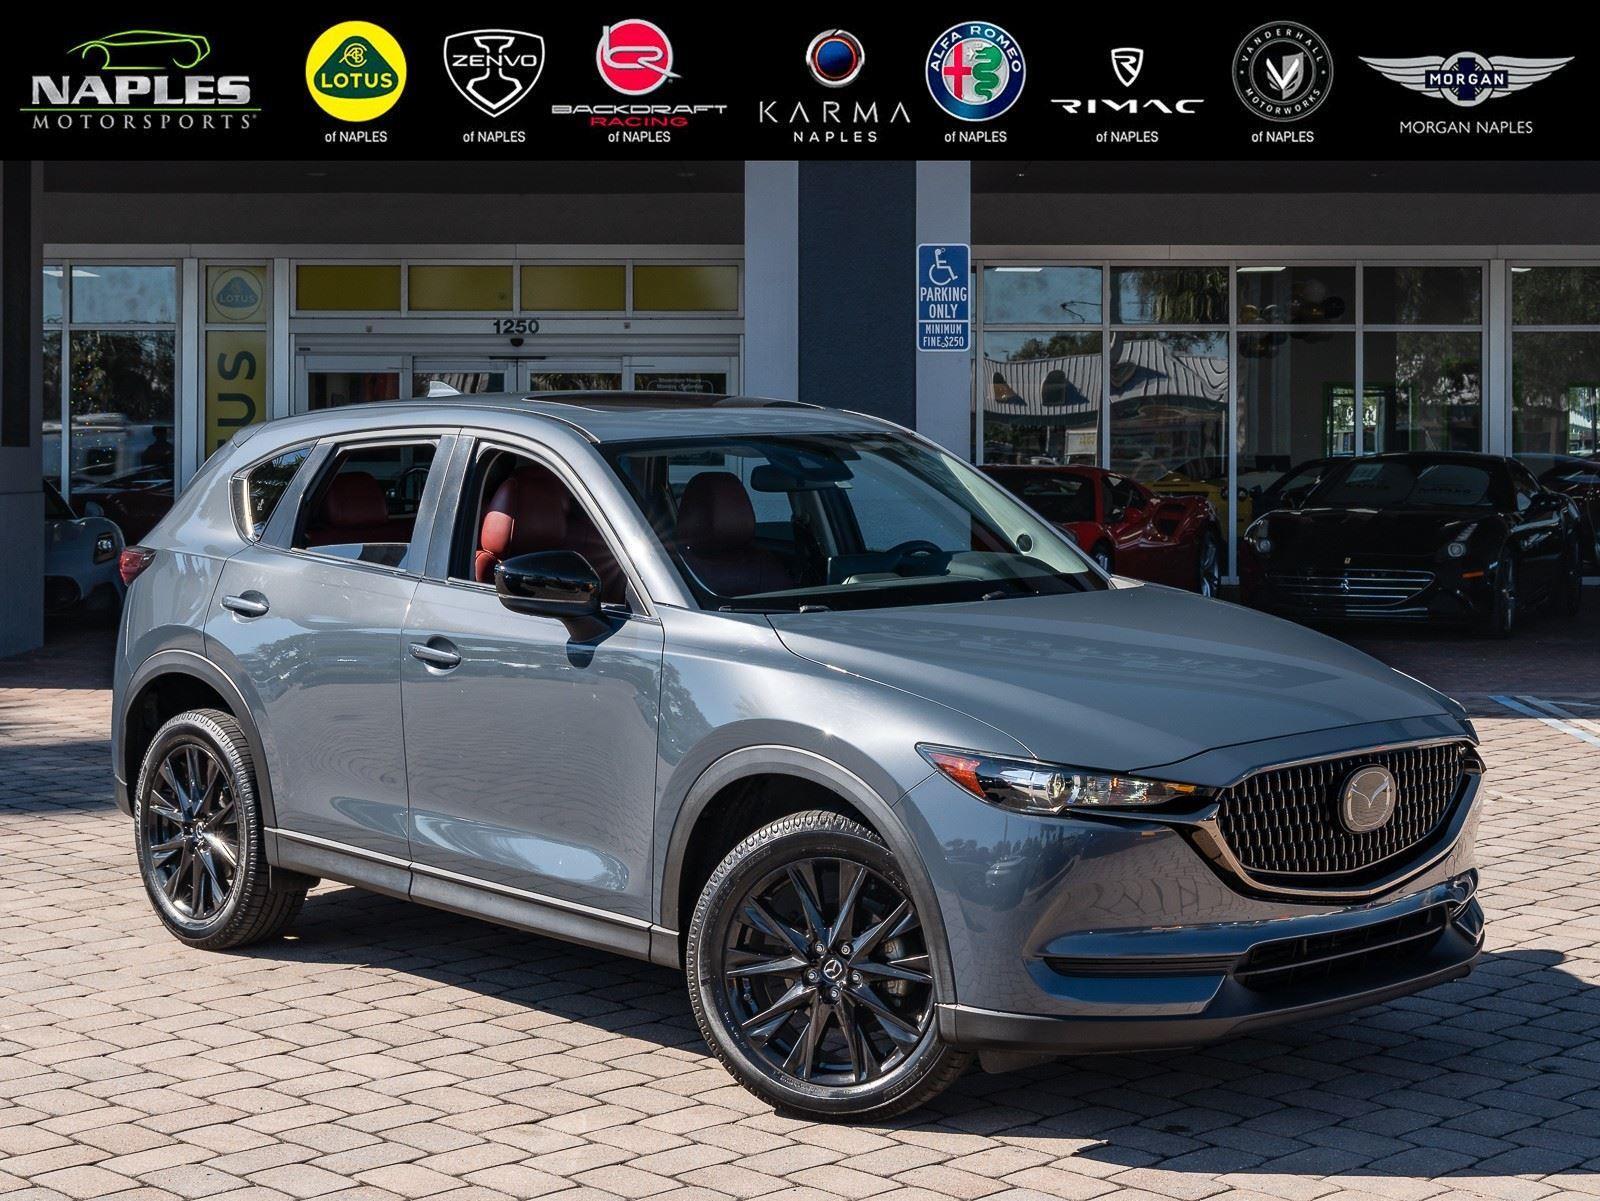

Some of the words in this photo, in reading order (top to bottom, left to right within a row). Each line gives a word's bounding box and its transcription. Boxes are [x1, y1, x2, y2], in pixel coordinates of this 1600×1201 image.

[219, 293, 257, 303] LOTUS
[920, 286, 967, 302] PARKING
[928, 303, 958, 319] ONLY
[493, 319, 540, 334] 1250
[925, 323, 962, 335] MINIMUM
[923, 336, 942, 347] FINE
[944, 335, 964, 348] $250
